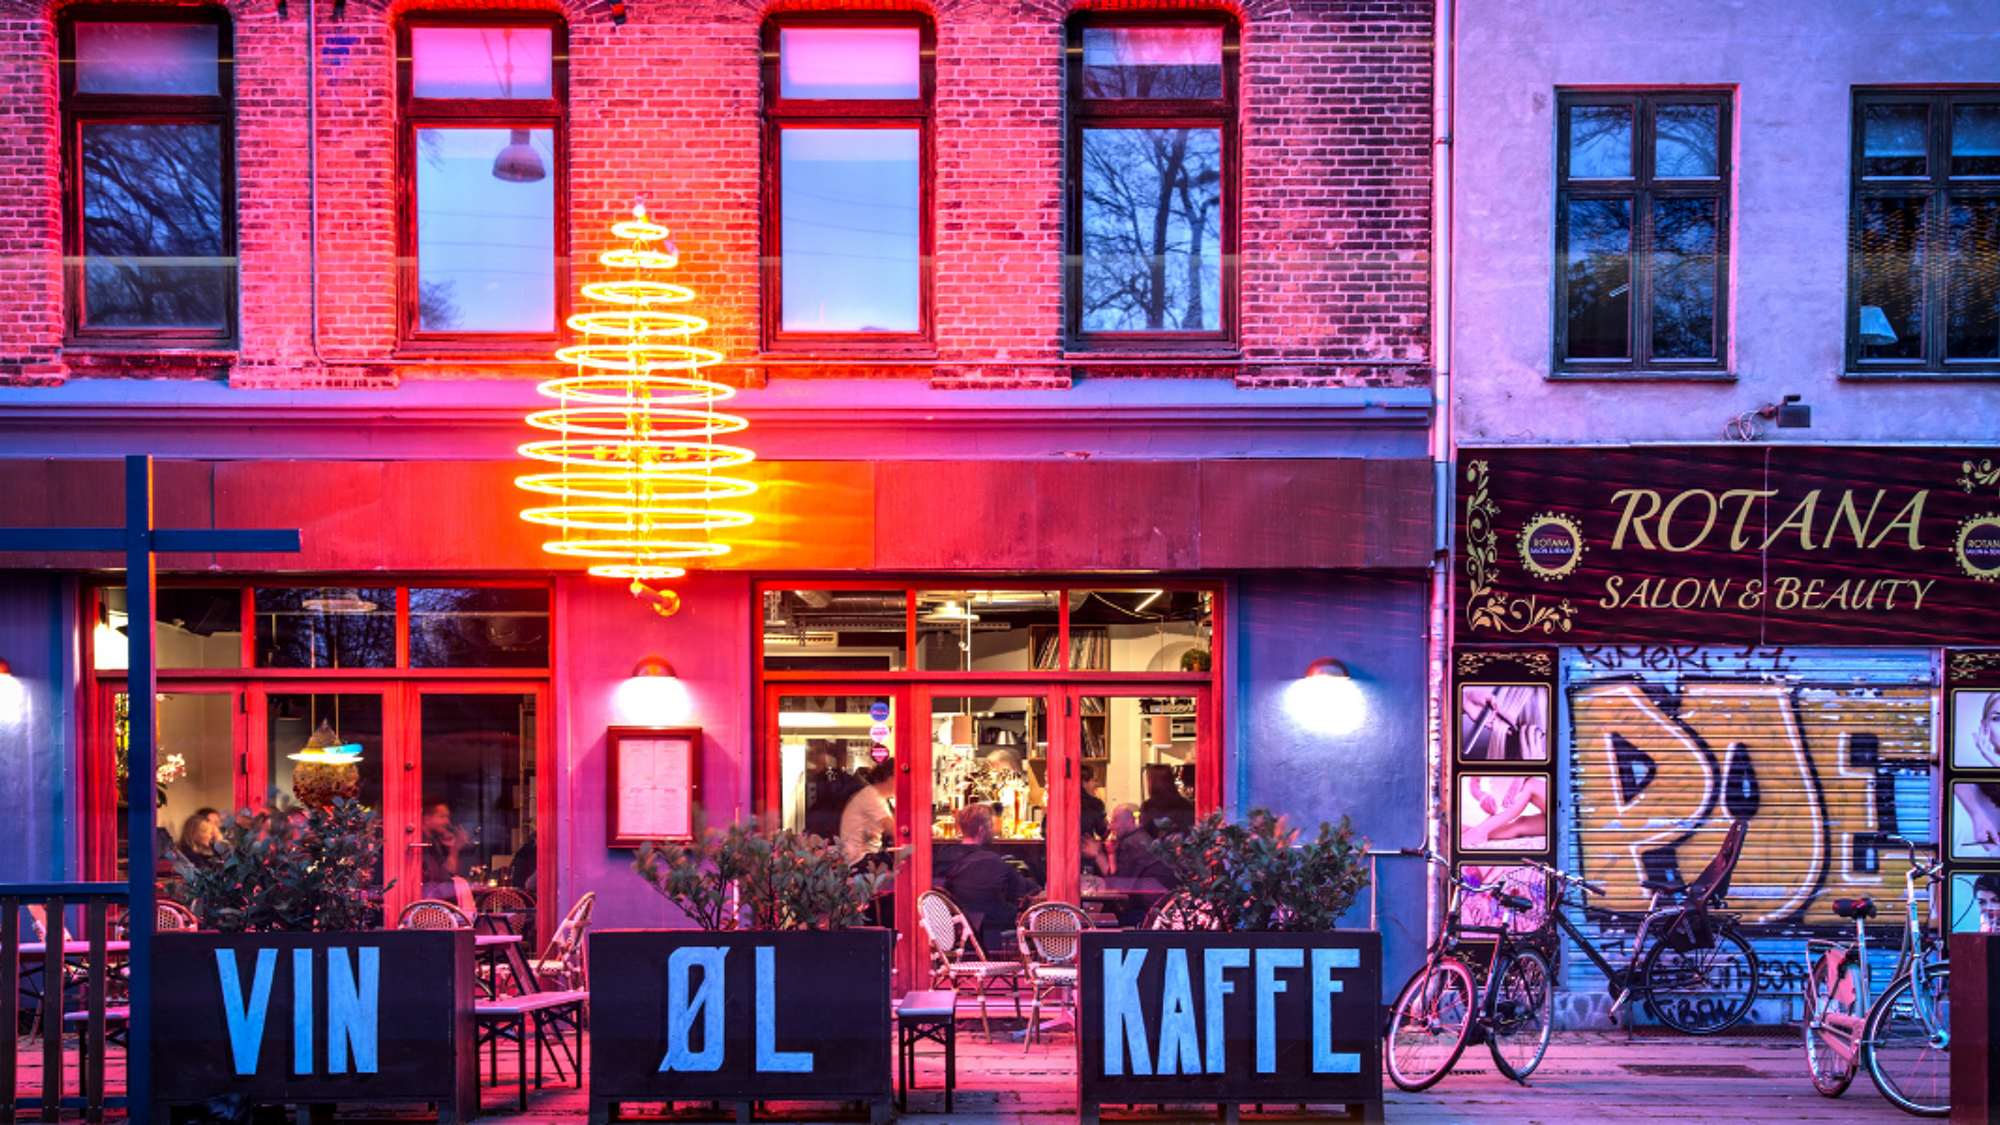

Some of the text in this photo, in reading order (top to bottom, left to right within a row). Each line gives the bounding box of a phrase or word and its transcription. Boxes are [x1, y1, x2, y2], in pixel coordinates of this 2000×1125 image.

[1533, 538, 1571, 548] ROTANA
[1611, 488, 1930, 552] ROTANA
[1600, 575, 1936, 610] SALON & BEAUTY
[215, 946, 380, 1075] VIN
[658, 945, 814, 1073] ØL
[1103, 948, 1361, 1075] KAFFE
